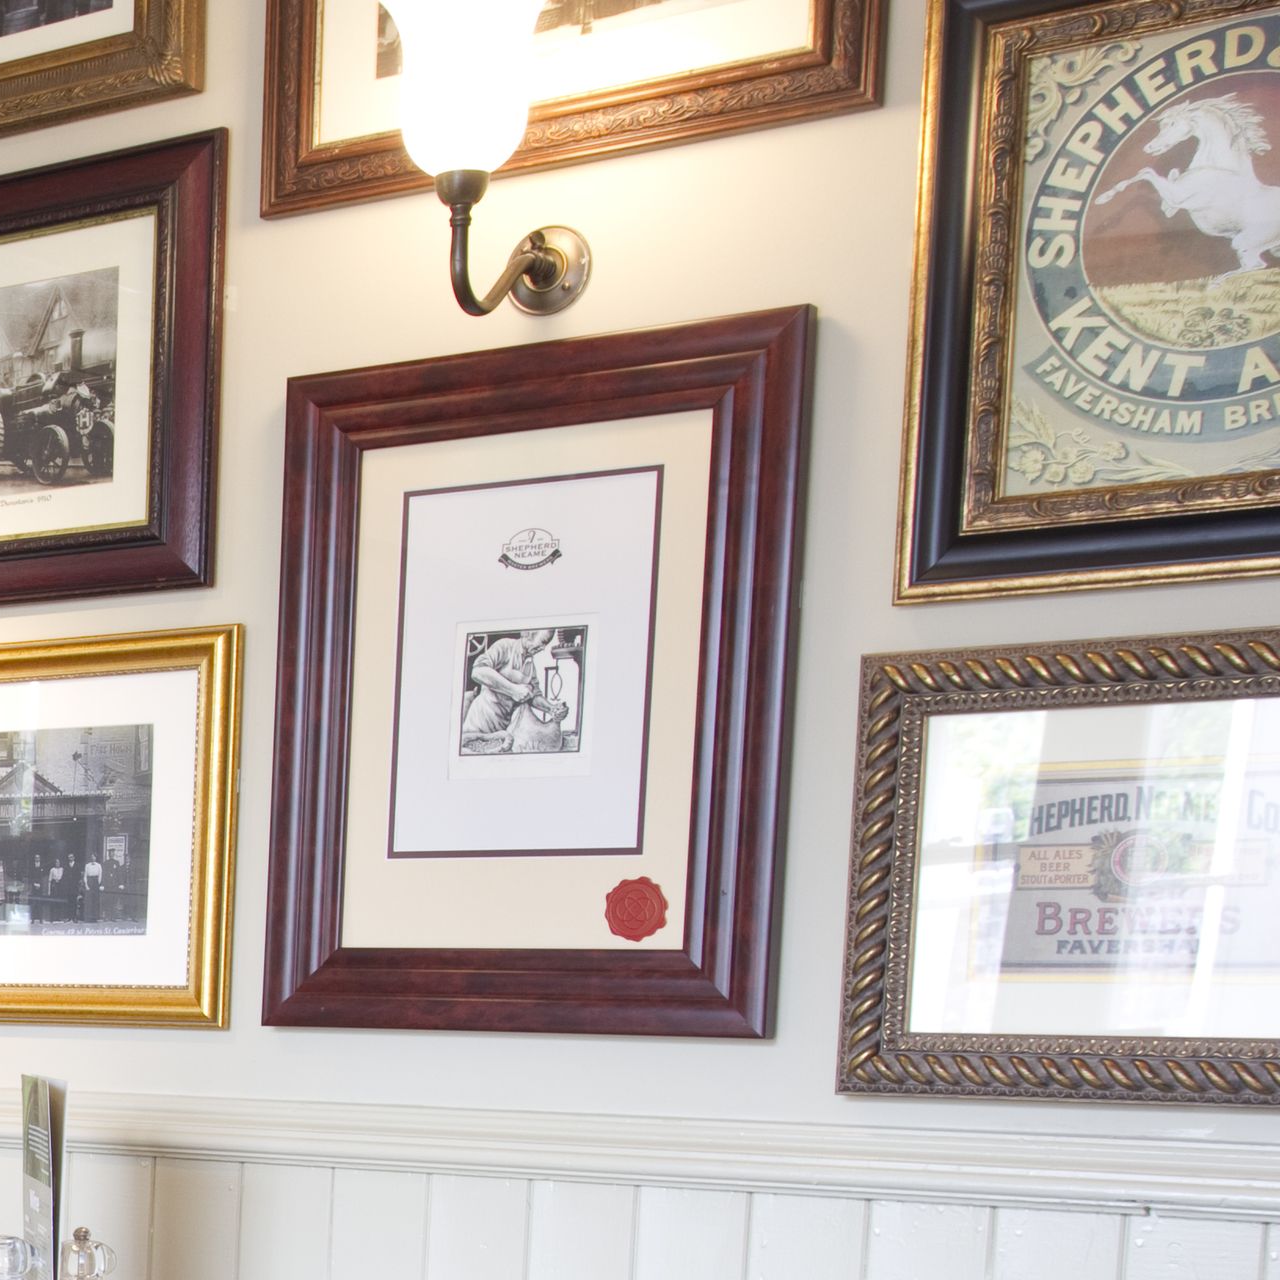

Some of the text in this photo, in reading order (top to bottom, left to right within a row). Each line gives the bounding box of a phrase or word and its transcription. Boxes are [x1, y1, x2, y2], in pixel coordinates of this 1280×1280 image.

[1048, 296, 1206, 397] KENT
[1035, 355, 1280, 436] FAVERSHAM BR
[505, 543, 556, 552] SHEPHERD
[514, 550, 547, 558] NEAME
[1028, 850, 1083, 861] ALL ALES
[1040, 862, 1071, 872] BEER
